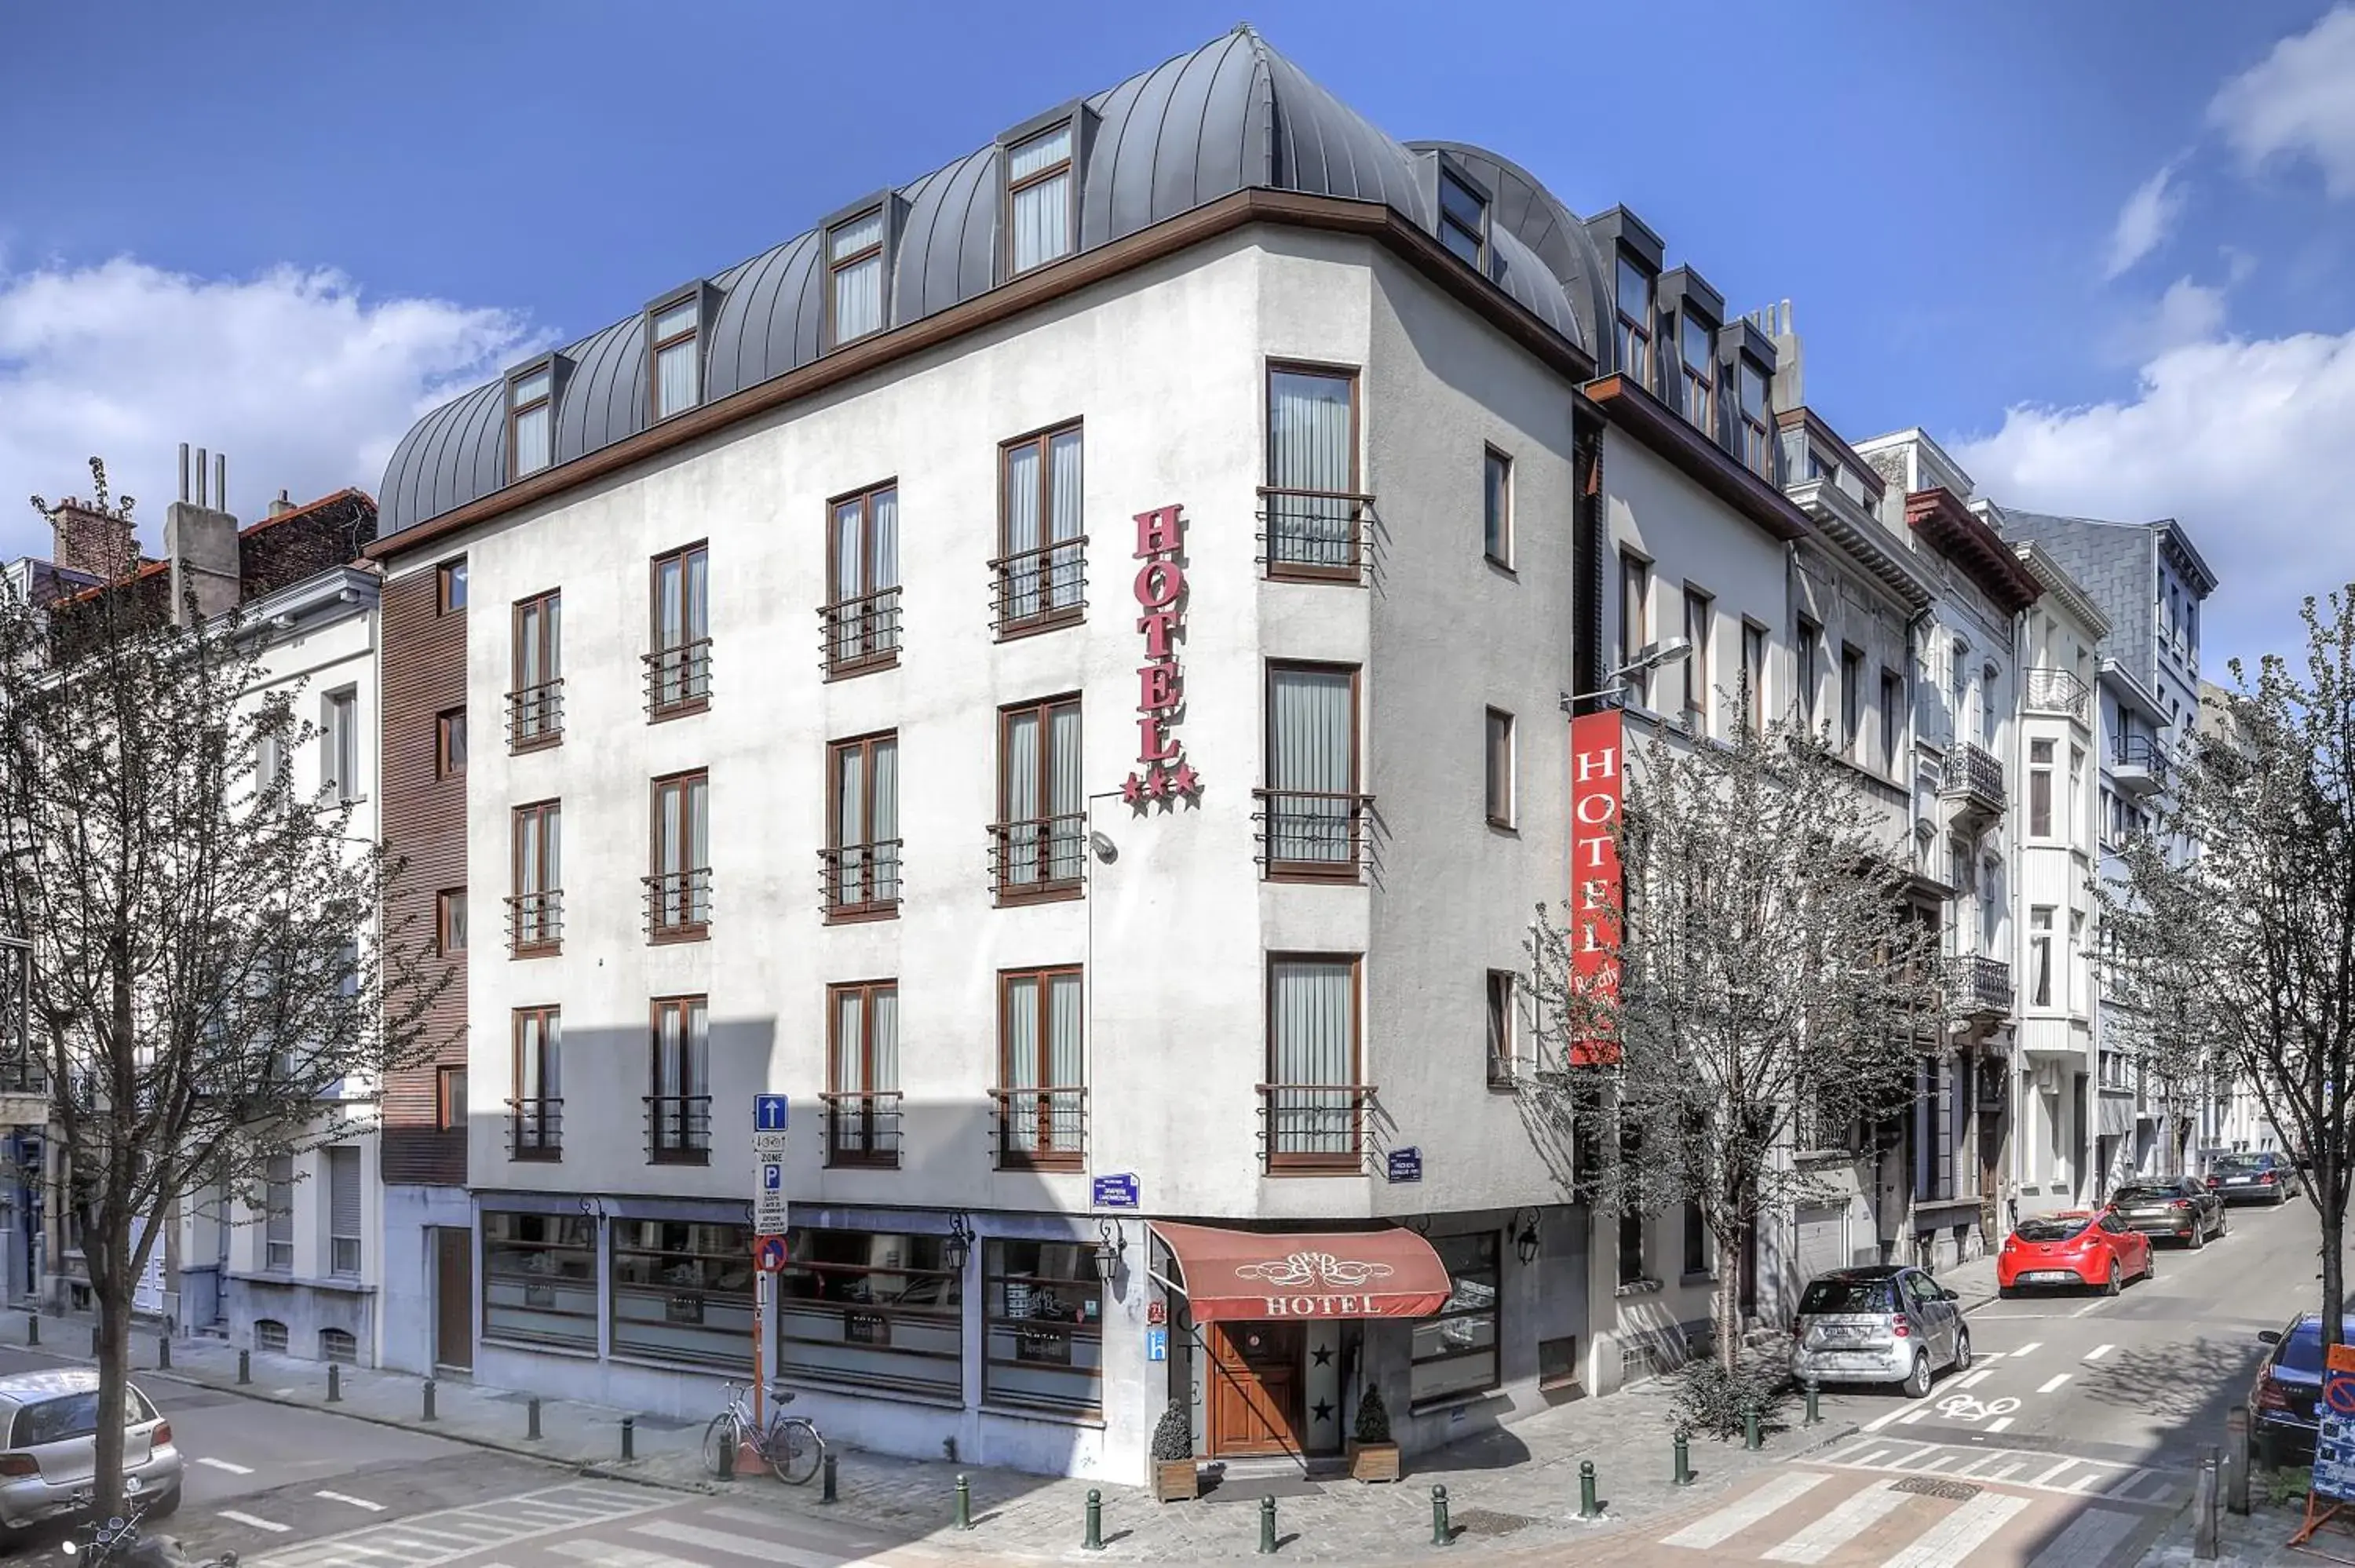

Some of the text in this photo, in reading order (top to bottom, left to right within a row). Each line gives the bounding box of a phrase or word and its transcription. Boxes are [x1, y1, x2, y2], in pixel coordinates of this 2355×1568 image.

[1132, 503, 1185, 764] HOTEL
[1575, 747, 1617, 953] HOTEL
[761, 1153, 783, 1162] ZONE
[1265, 1294, 1382, 1316] HOTEL
